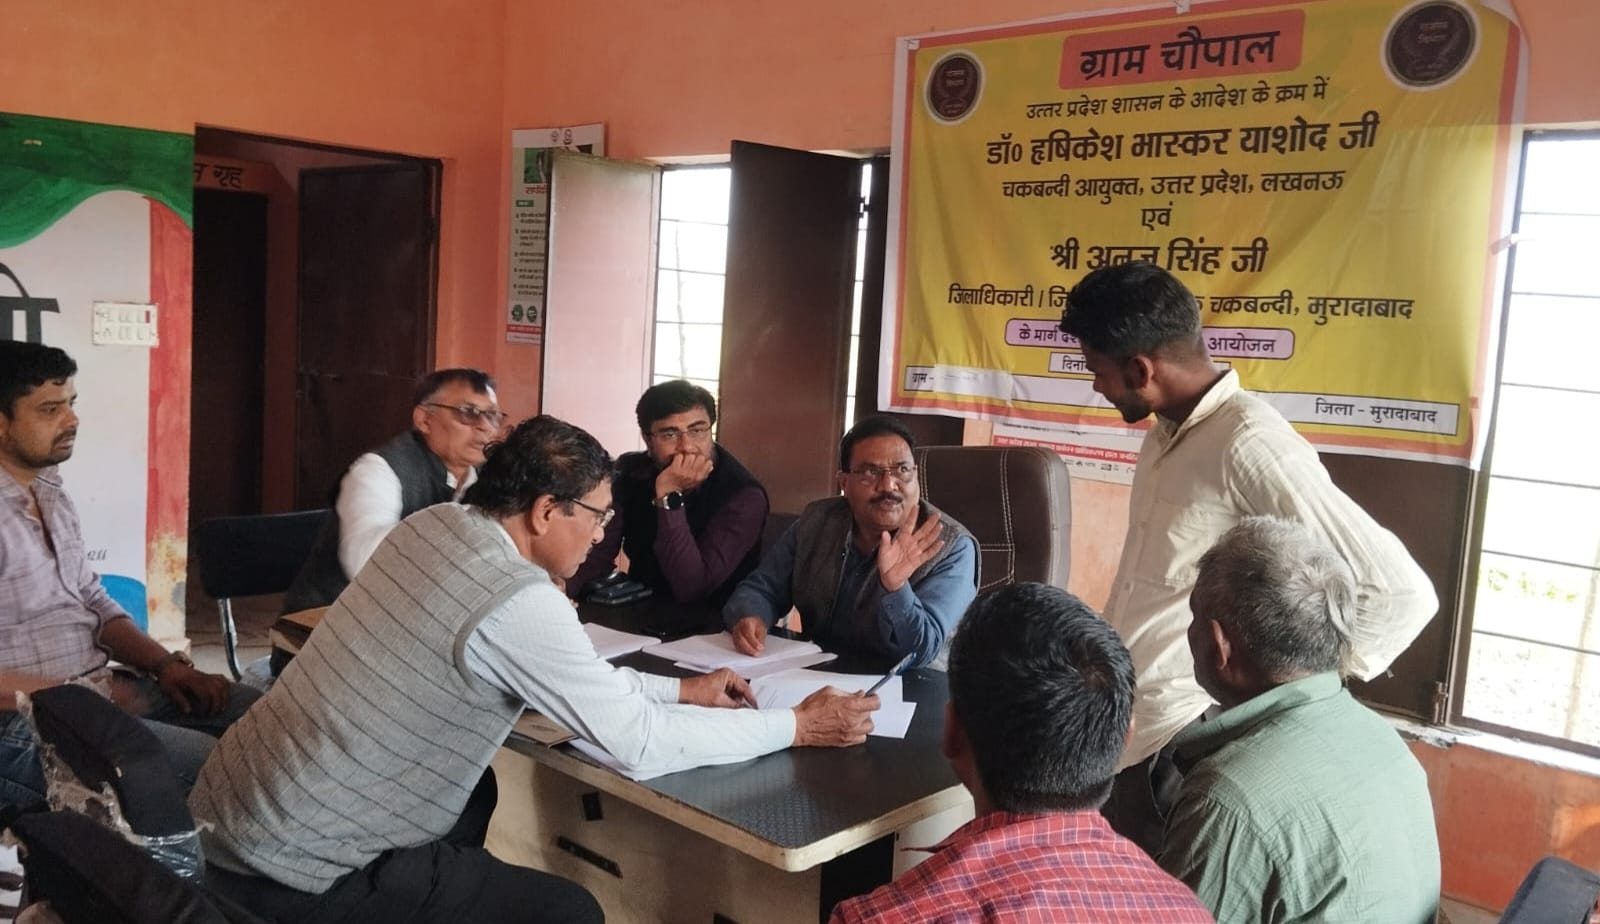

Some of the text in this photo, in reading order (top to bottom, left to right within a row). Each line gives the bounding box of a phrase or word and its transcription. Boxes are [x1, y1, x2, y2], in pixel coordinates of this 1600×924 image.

[1079, 25, 1280, 81] ग्राम चौपाल
[1026, 75, 1331, 119] उत्तर प्रदेश शासन के आदेश के क्रम में
[1030, 127, 1124, 166] हृषिकेश
[1131, 128, 1232, 158] भास्कर
[1240, 115, 1331, 155] याशोद
[1338, 110, 1380, 150] जी
[1003, 168, 1347, 205] चकबन्दी आयुक्त, उत्तर प्रदेश, लखनऊ
[1141, 201, 1174, 231] एवं
[1051, 236, 1269, 275] श्री अनज सिंह जी
[948, 283, 1034, 307] जिलाधिकारी
[1210, 289, 1300, 316] चकबन्दी,
[1307, 297, 1415, 326] मुरादाबाद
[1019, 323, 1031, 341] के
[1034, 325, 1058, 343] मार्ग
[1207, 332, 1277, 353] आयोजन
[1062, 355, 1088, 372] दिनां
[1315, 397, 1355, 417] जिला
[1370, 405, 1438, 424] मुरादाबाद
